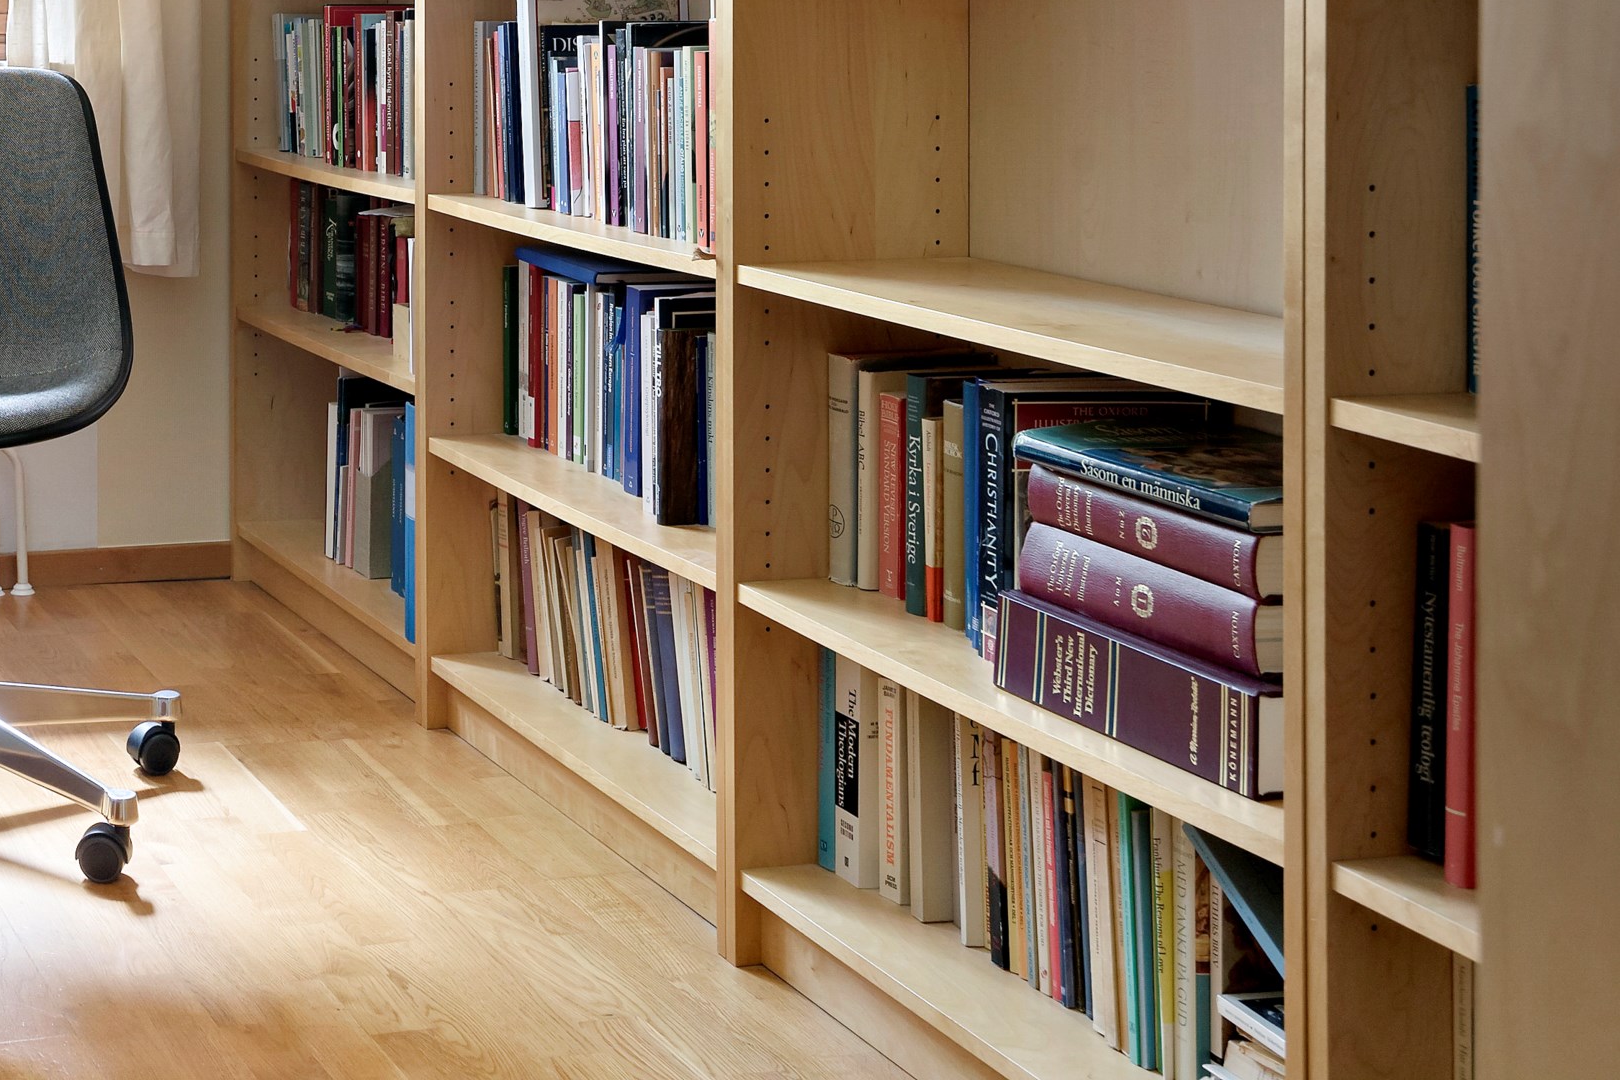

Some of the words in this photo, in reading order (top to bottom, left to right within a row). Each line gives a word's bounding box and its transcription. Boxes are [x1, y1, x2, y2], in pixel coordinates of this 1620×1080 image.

[706, 376, 714, 418] Känslans
[882, 400, 898, 411] HOLY
[882, 409, 899, 420] BIBLE
[983, 408, 1000, 418] OXFORD
[1072, 406, 1094, 416] THE
[1098, 406, 1148, 416] OXFORD
[858, 410, 866, 438] Bibel
[906, 435, 922, 486] Kyrka
[1056, 476, 1066, 511] Oxford
[1080, 458, 1118, 484] Såsom
[1122, 476, 1136, 490] en
[1140, 481, 1200, 511] människa
[984, 433, 998, 589] CHRISTIANITY
[1064, 484, 1072, 527] Universal
[1073, 484, 1081, 532] Dictionary
[1084, 490, 1094, 536] Illustrated
[1118, 510, 1126, 518] Z
[906, 501, 921, 565] Sverige
[1118, 531, 1126, 540] N
[1120, 520, 1125, 530] to
[1143, 528, 1150, 538] 2
[1050, 540, 1064, 578] Oxford
[1056, 548, 1070, 591] Universal
[1064, 550, 1080, 598] Dictionary
[1232, 539, 1242, 588] CAXTON
[1455, 544, 1467, 592] Bultmann
[1047, 582, 1056, 594] The
[1077, 555, 1091, 602] Illustrated
[1114, 588, 1120, 598] to
[1115, 576, 1122, 586] M
[1113, 599, 1120, 607] A
[1064, 634, 1074, 665] New
[1232, 610, 1240, 659] CAXTON
[1454, 622, 1464, 640] The
[1052, 634, 1064, 696] Webster's
[1073, 631, 1085, 718] International
[1417, 591, 1437, 720] Nytestamentlig
[1452, 642, 1463, 692] Johannine
[882, 684, 896, 694] JAMES
[1062, 666, 1073, 704] Third
[1084, 644, 1098, 714] Dictionary
[848, 689, 856, 717] The
[1452, 694, 1462, 732] Epistles
[848, 720, 856, 779] Modern
[1229, 696, 1238, 782] KÖNEMANN
[1416, 724, 1435, 785] teologi
[836, 721, 846, 807] Theologians
[885, 708, 894, 866] FUNDAMENTALISM
[840, 818, 854, 832] SECOND
[840, 827, 854, 841] EDITION
[1153, 837, 1162, 878] Frankfurt
[886, 874, 896, 882] SCM
[1156, 882, 1164, 901] The
[1176, 860, 1186, 898] MED
[1156, 904, 1164, 939] Reasons
[1212, 884, 1220, 937] LUTHERS
[1177, 904, 1186, 958] TANKE
[1158, 951, 1166, 974] Love
[1178, 962, 1188, 981] PÅ
[1212, 938, 1220, 968] BREV
[1178, 987, 1188, 1027] GUD
